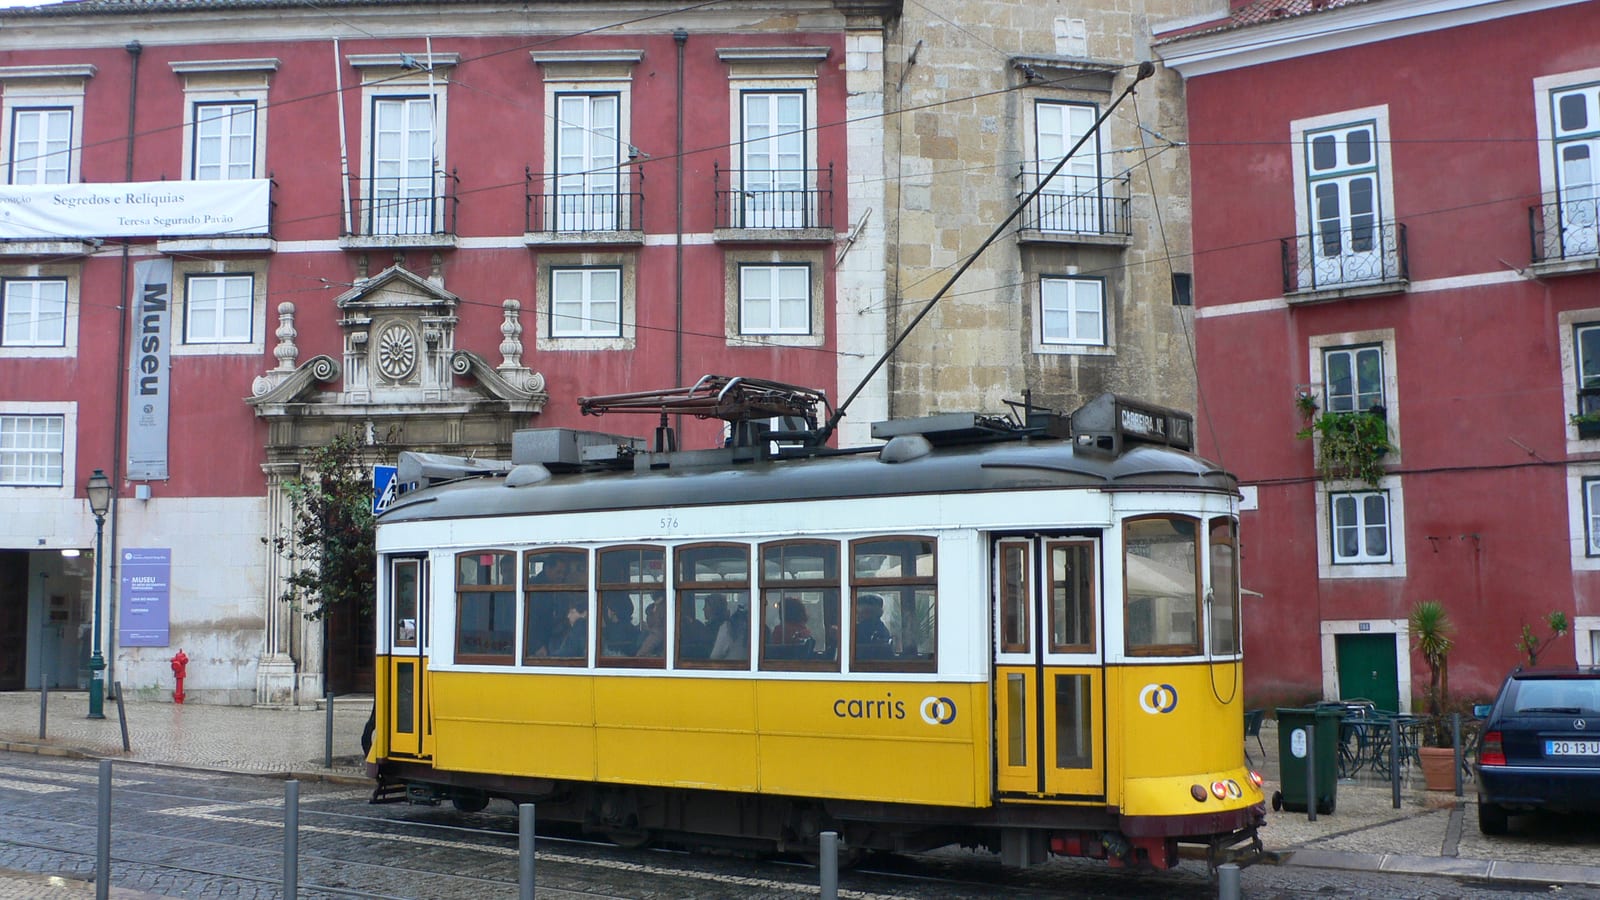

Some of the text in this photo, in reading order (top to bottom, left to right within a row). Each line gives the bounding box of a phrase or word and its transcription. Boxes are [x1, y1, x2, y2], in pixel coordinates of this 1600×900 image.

[53, 193, 184, 208] Segredos e Relíquias
[117, 214, 233, 228] Teresa Segurado Pavão
[140, 283, 167, 395] Museu
[1121, 409, 1154, 432] CARREIRA
[660, 517, 679, 529] 576
[833, 692, 906, 720] carris
